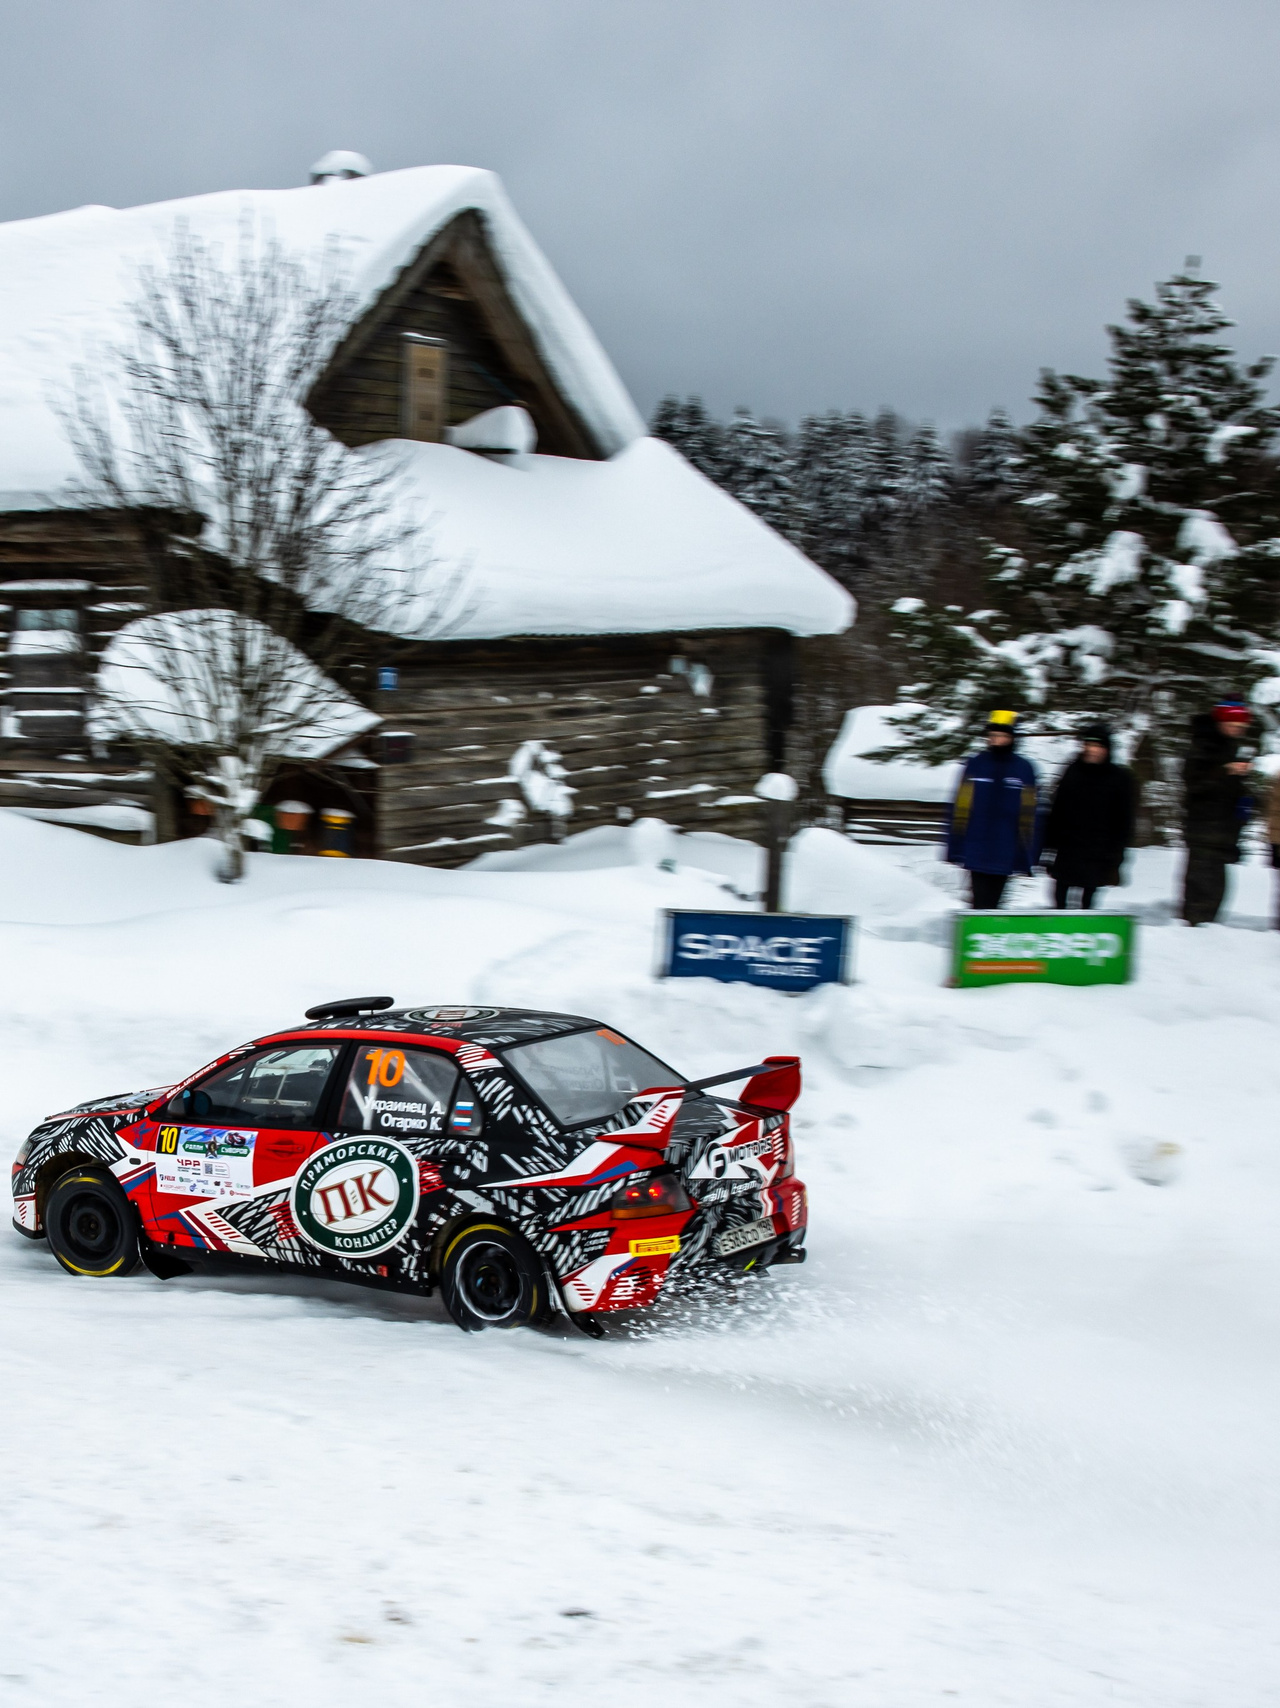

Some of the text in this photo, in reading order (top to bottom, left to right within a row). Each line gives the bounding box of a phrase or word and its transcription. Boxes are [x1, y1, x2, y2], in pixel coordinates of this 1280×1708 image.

[677, 933, 832, 963] SPACE
[365, 1049, 405, 1087] 10
[364, 1096, 445, 1116] Украинец А.
[380, 1113, 442, 1131] Огарко К.
[160, 1127, 178, 1153] 10
[728, 1136, 774, 1164] MOTORS
[300, 1144, 399, 1190] ПРИМОРСКИЙ
[314, 1167, 394, 1226] ПК
[334, 1218, 397, 1249] КОНДИТЕР
